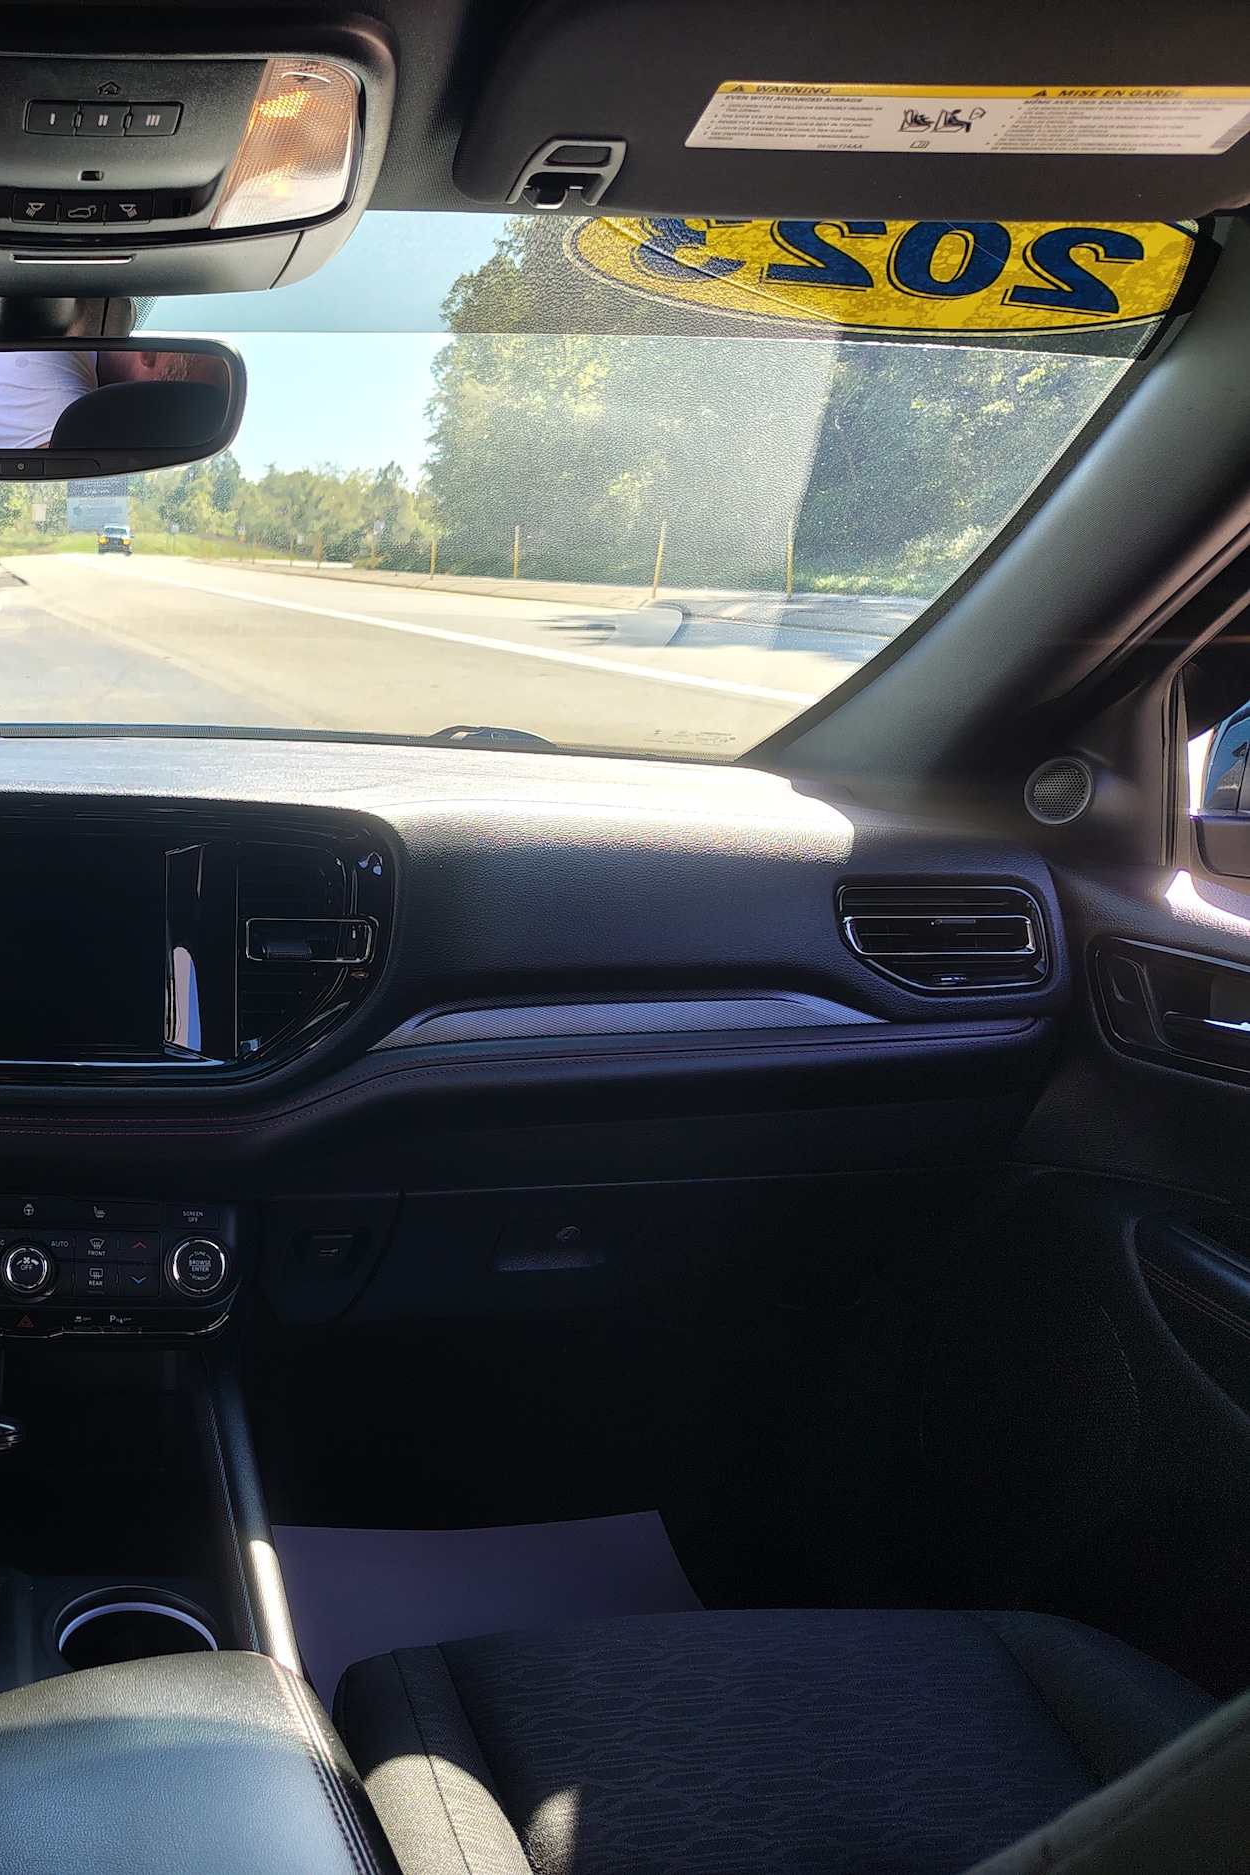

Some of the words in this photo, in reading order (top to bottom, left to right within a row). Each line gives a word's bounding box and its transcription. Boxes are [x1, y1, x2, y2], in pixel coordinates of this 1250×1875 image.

[755, 85, 833, 95] WARNING
[51, 1240, 69, 1248] AUTO
[191, 1274, 210, 1282] SCROLL
